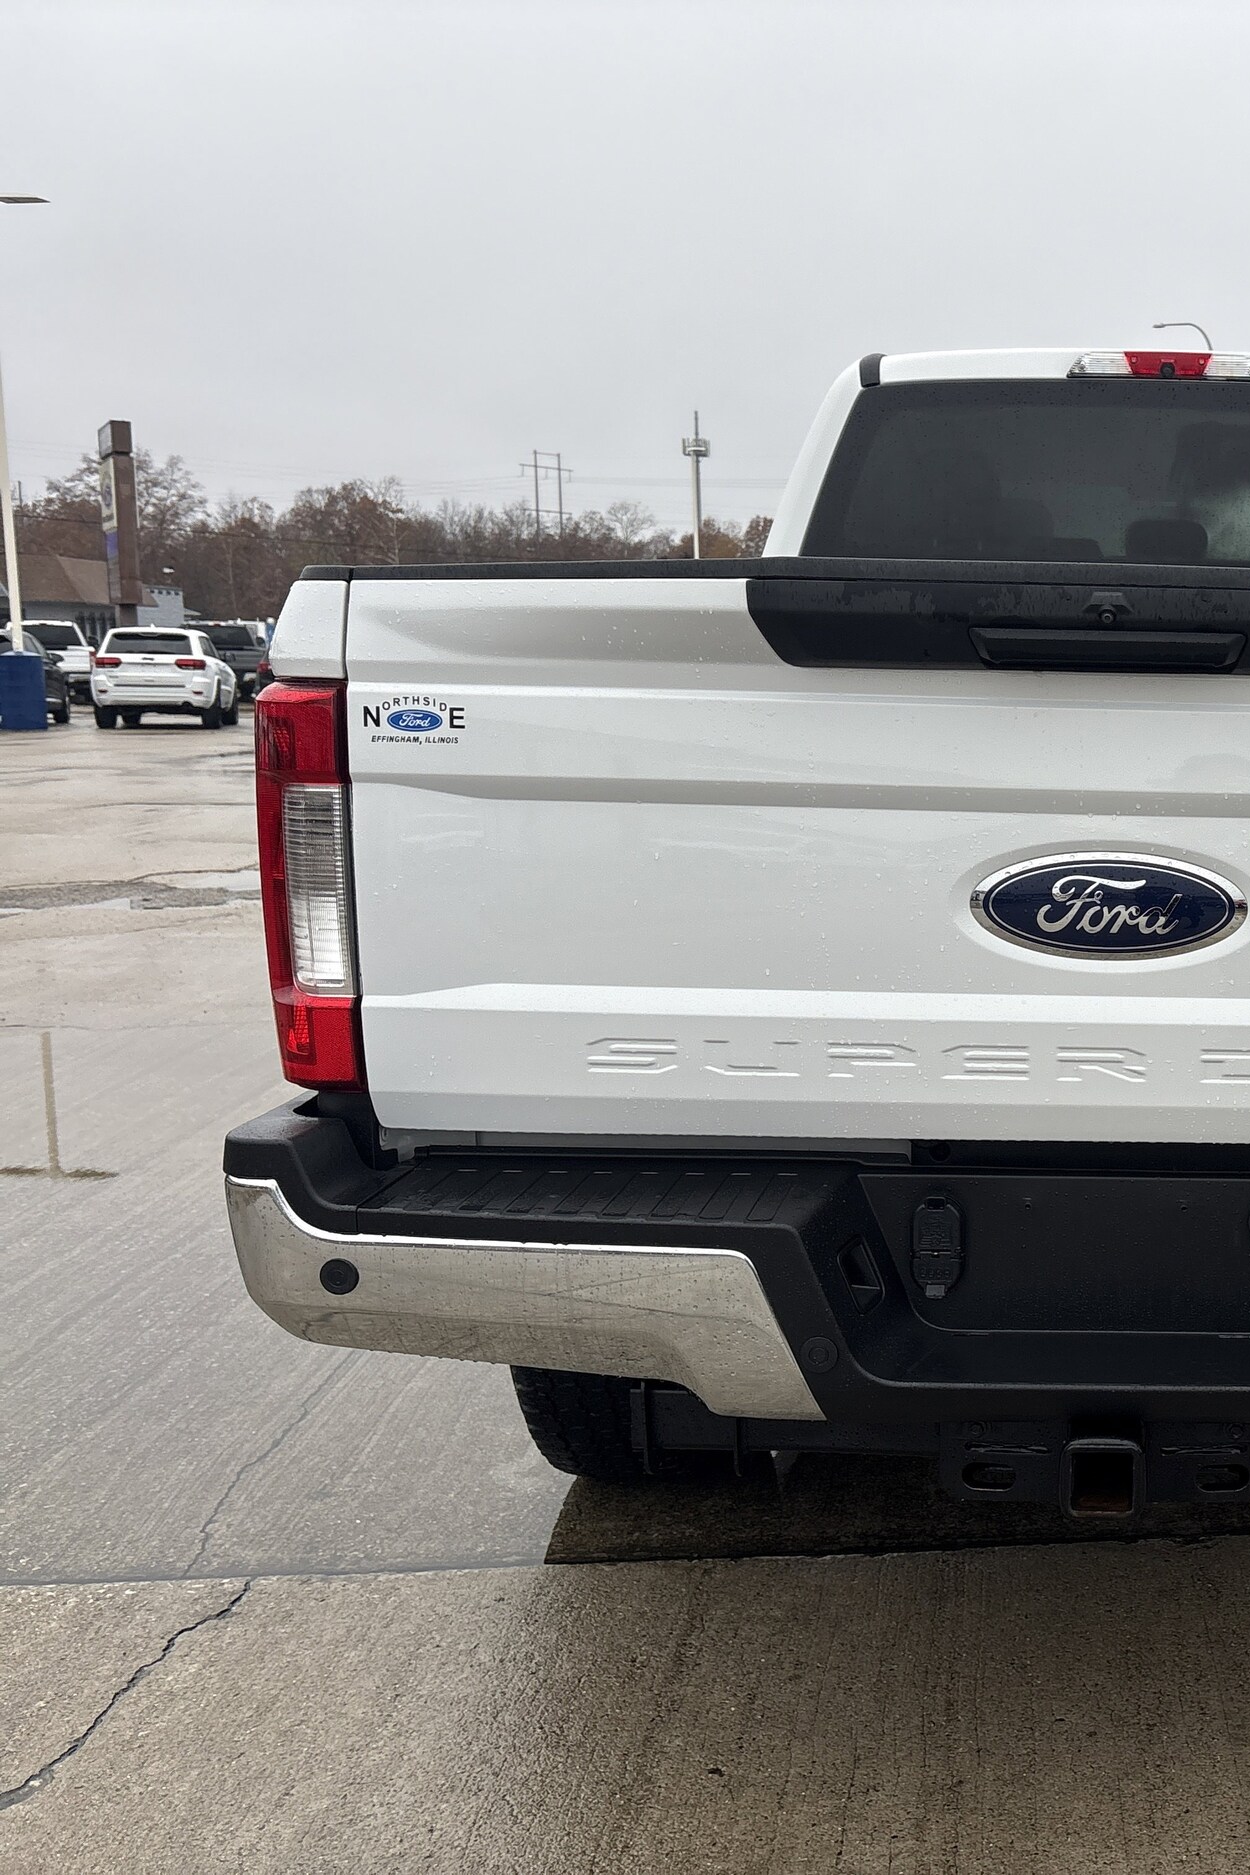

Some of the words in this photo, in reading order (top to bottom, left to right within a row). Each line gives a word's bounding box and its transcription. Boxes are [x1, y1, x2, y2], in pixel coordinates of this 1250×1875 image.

[363, 696, 465, 729] NORTHSIDE
[399, 713, 430, 727] Ford
[371, 735, 422, 745] EFFINGHAM,
[425, 736, 459, 744] ILLINOIS
[1036, 875, 1183, 935] Ford
[587, 1037, 1146, 1083] SUPER
